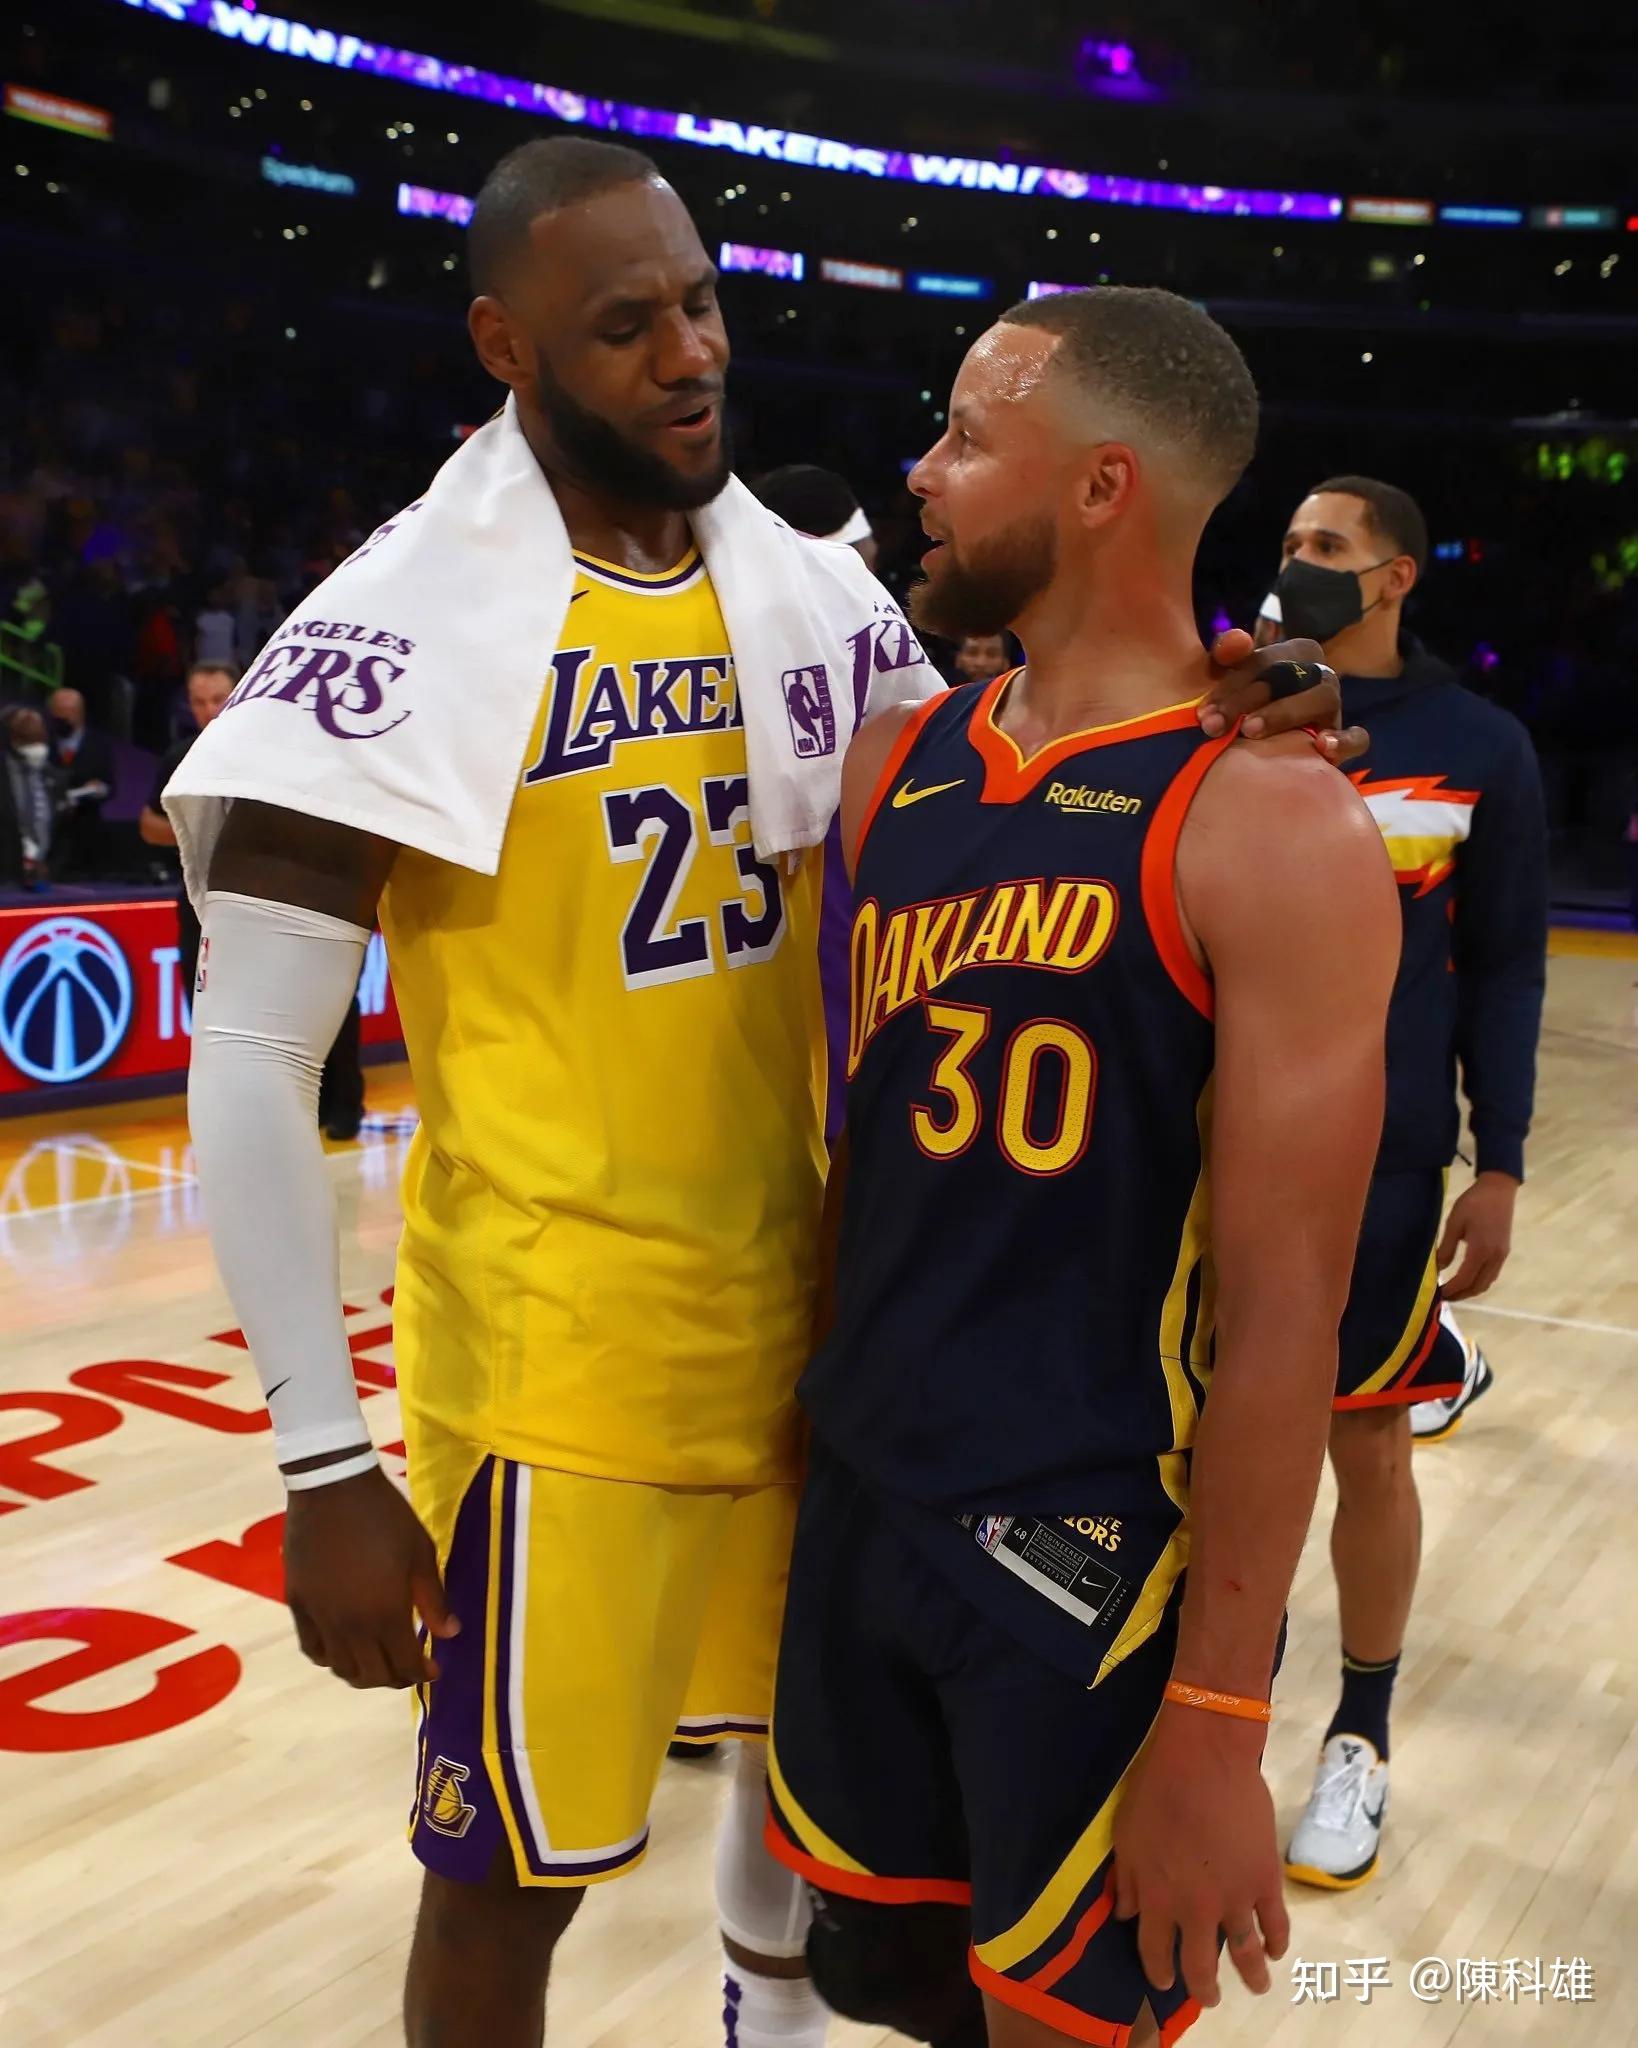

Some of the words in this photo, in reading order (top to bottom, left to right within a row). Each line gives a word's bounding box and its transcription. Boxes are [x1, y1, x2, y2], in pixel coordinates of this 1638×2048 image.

[676, 112, 888, 177] LAKERS
[907, 152, 1045, 195] WIN!
[220, 645, 411, 739] ERS
[1044, 781, 1143, 816] Rakuten
[600, 773, 788, 992] 23
[844, 876, 1121, 1082] OAKLAND
[909, 996, 1098, 1178] 30
[1013, 1526, 1028, 1541] 48
